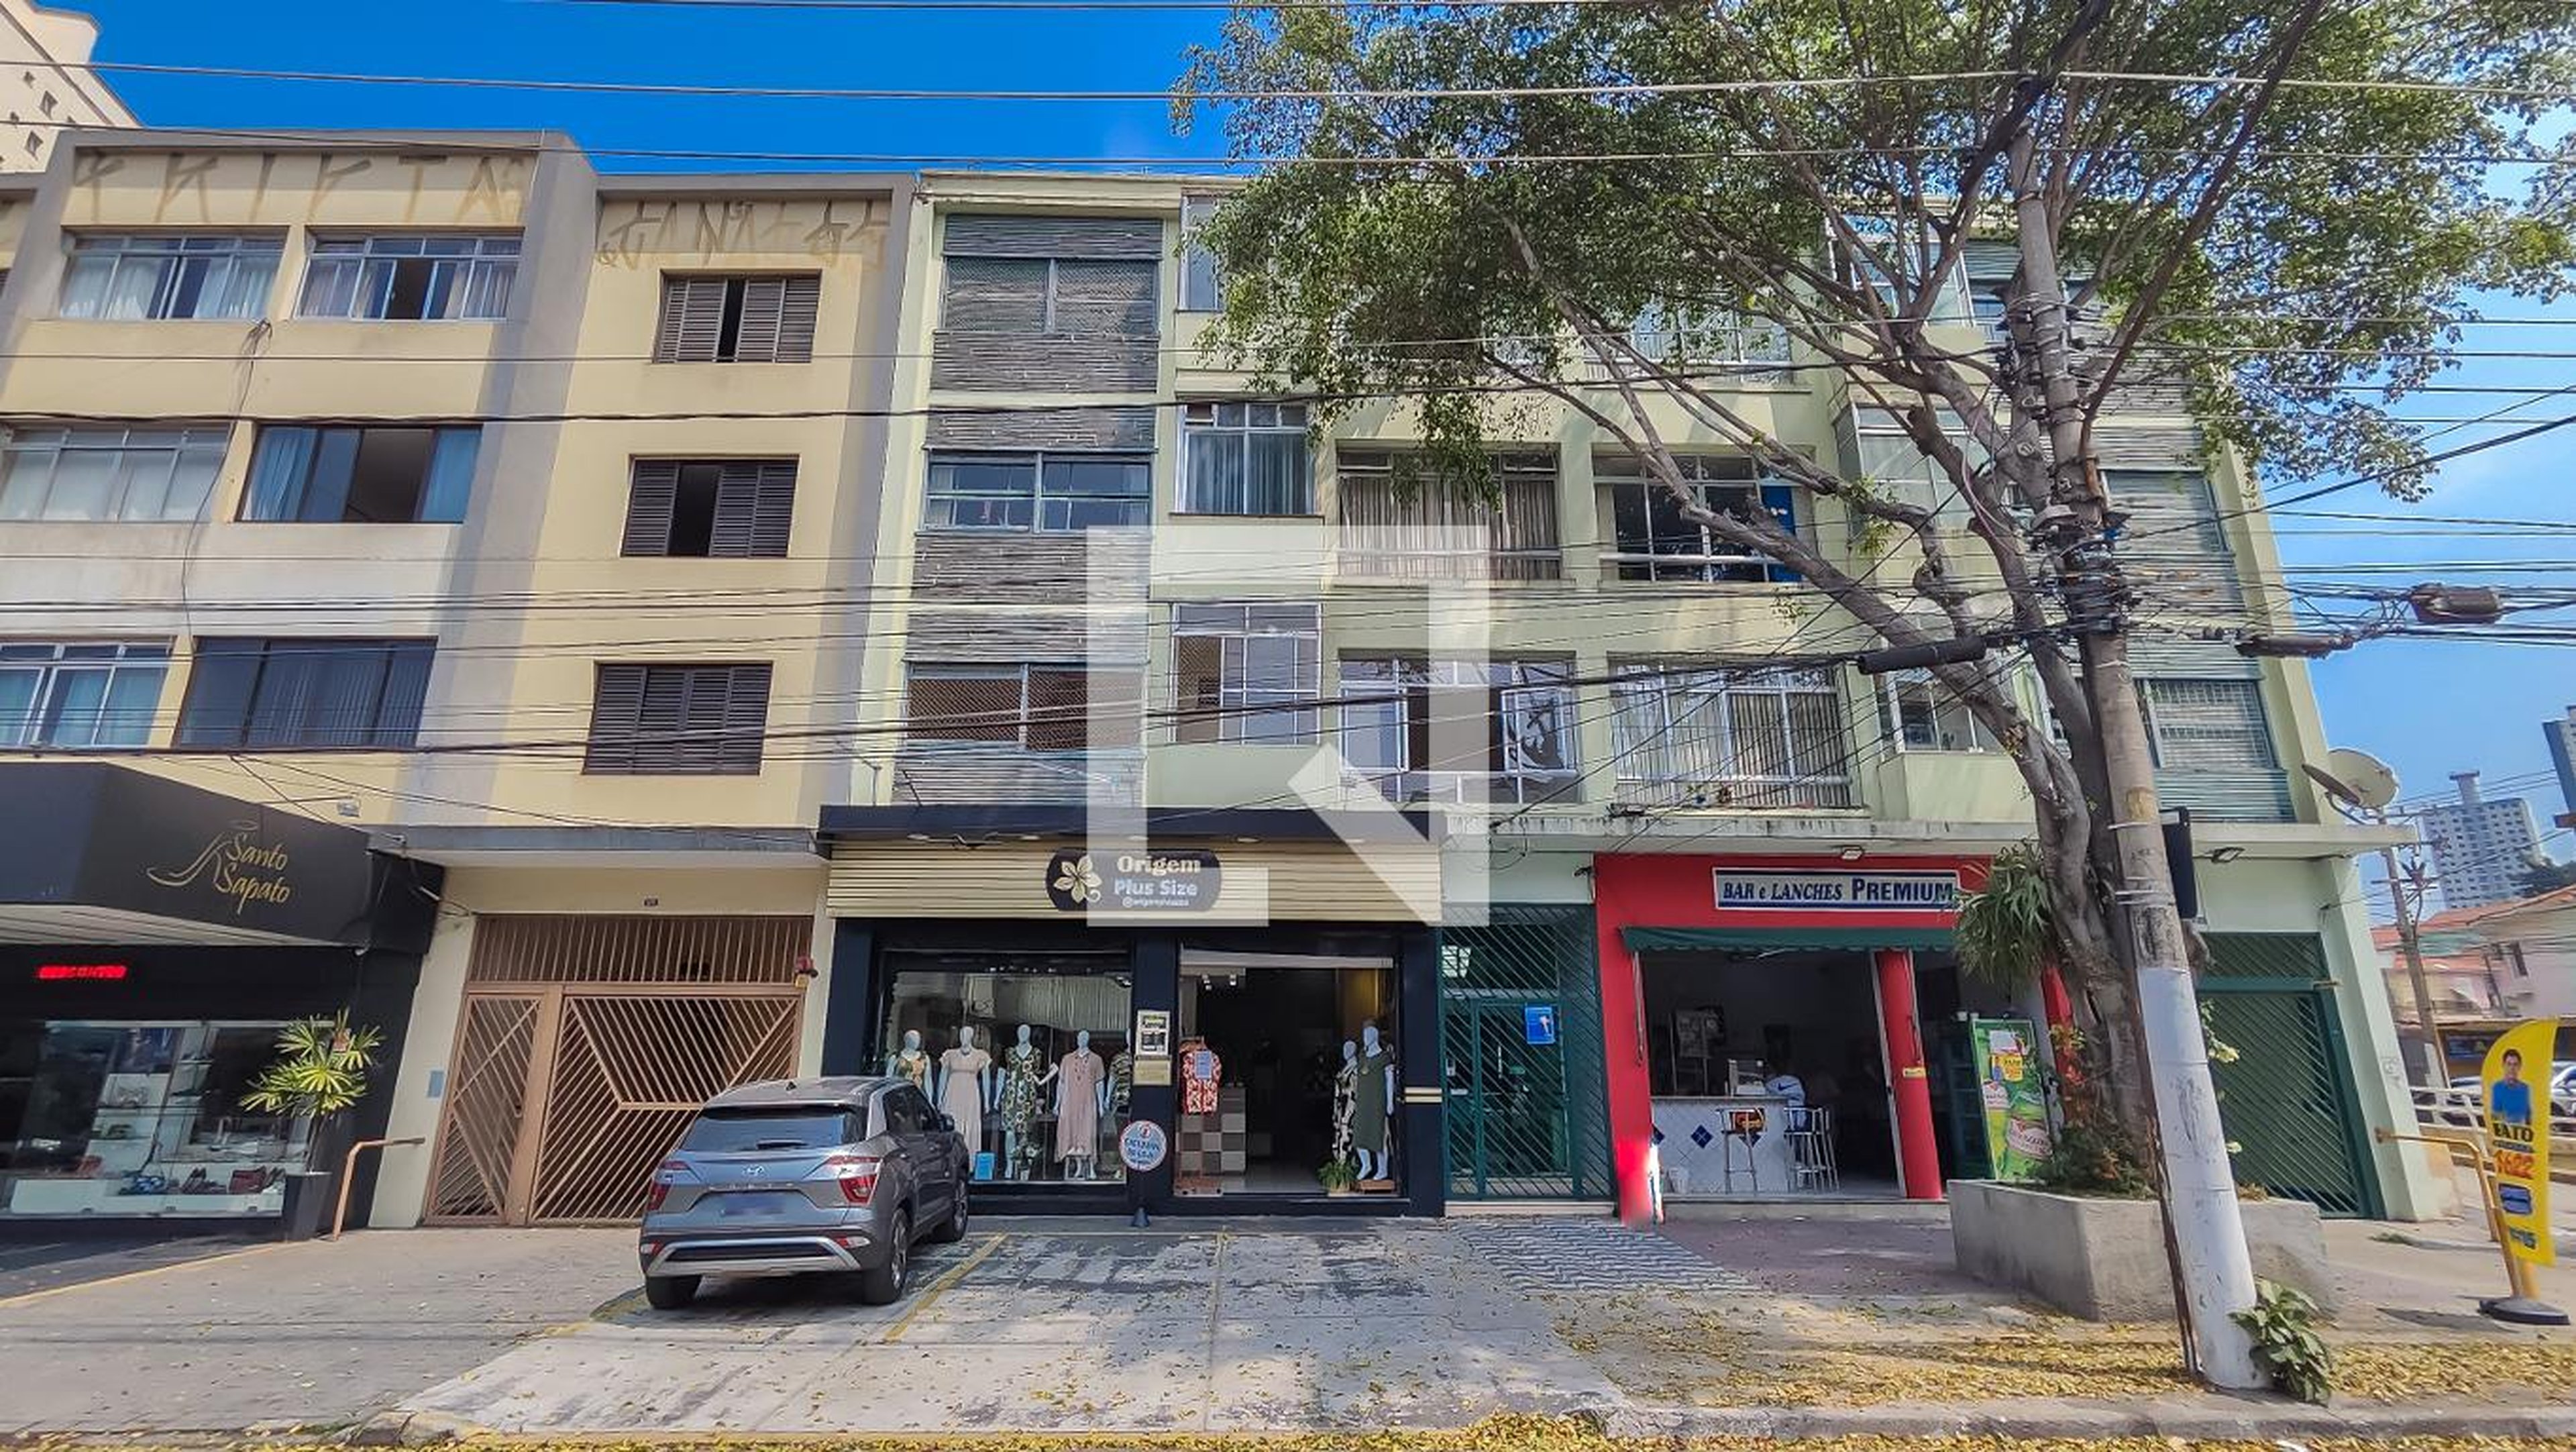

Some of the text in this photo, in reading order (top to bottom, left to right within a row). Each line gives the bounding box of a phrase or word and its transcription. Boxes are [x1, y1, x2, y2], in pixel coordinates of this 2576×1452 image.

[225, 831, 288, 870] Santo
[1117, 855, 1201, 876] Origem
[215, 862, 290, 915] Sapato
[1114, 878, 1198, 896] Plus Size
[1723, 878, 1953, 901] BAR e LANCHES PREMIUM
